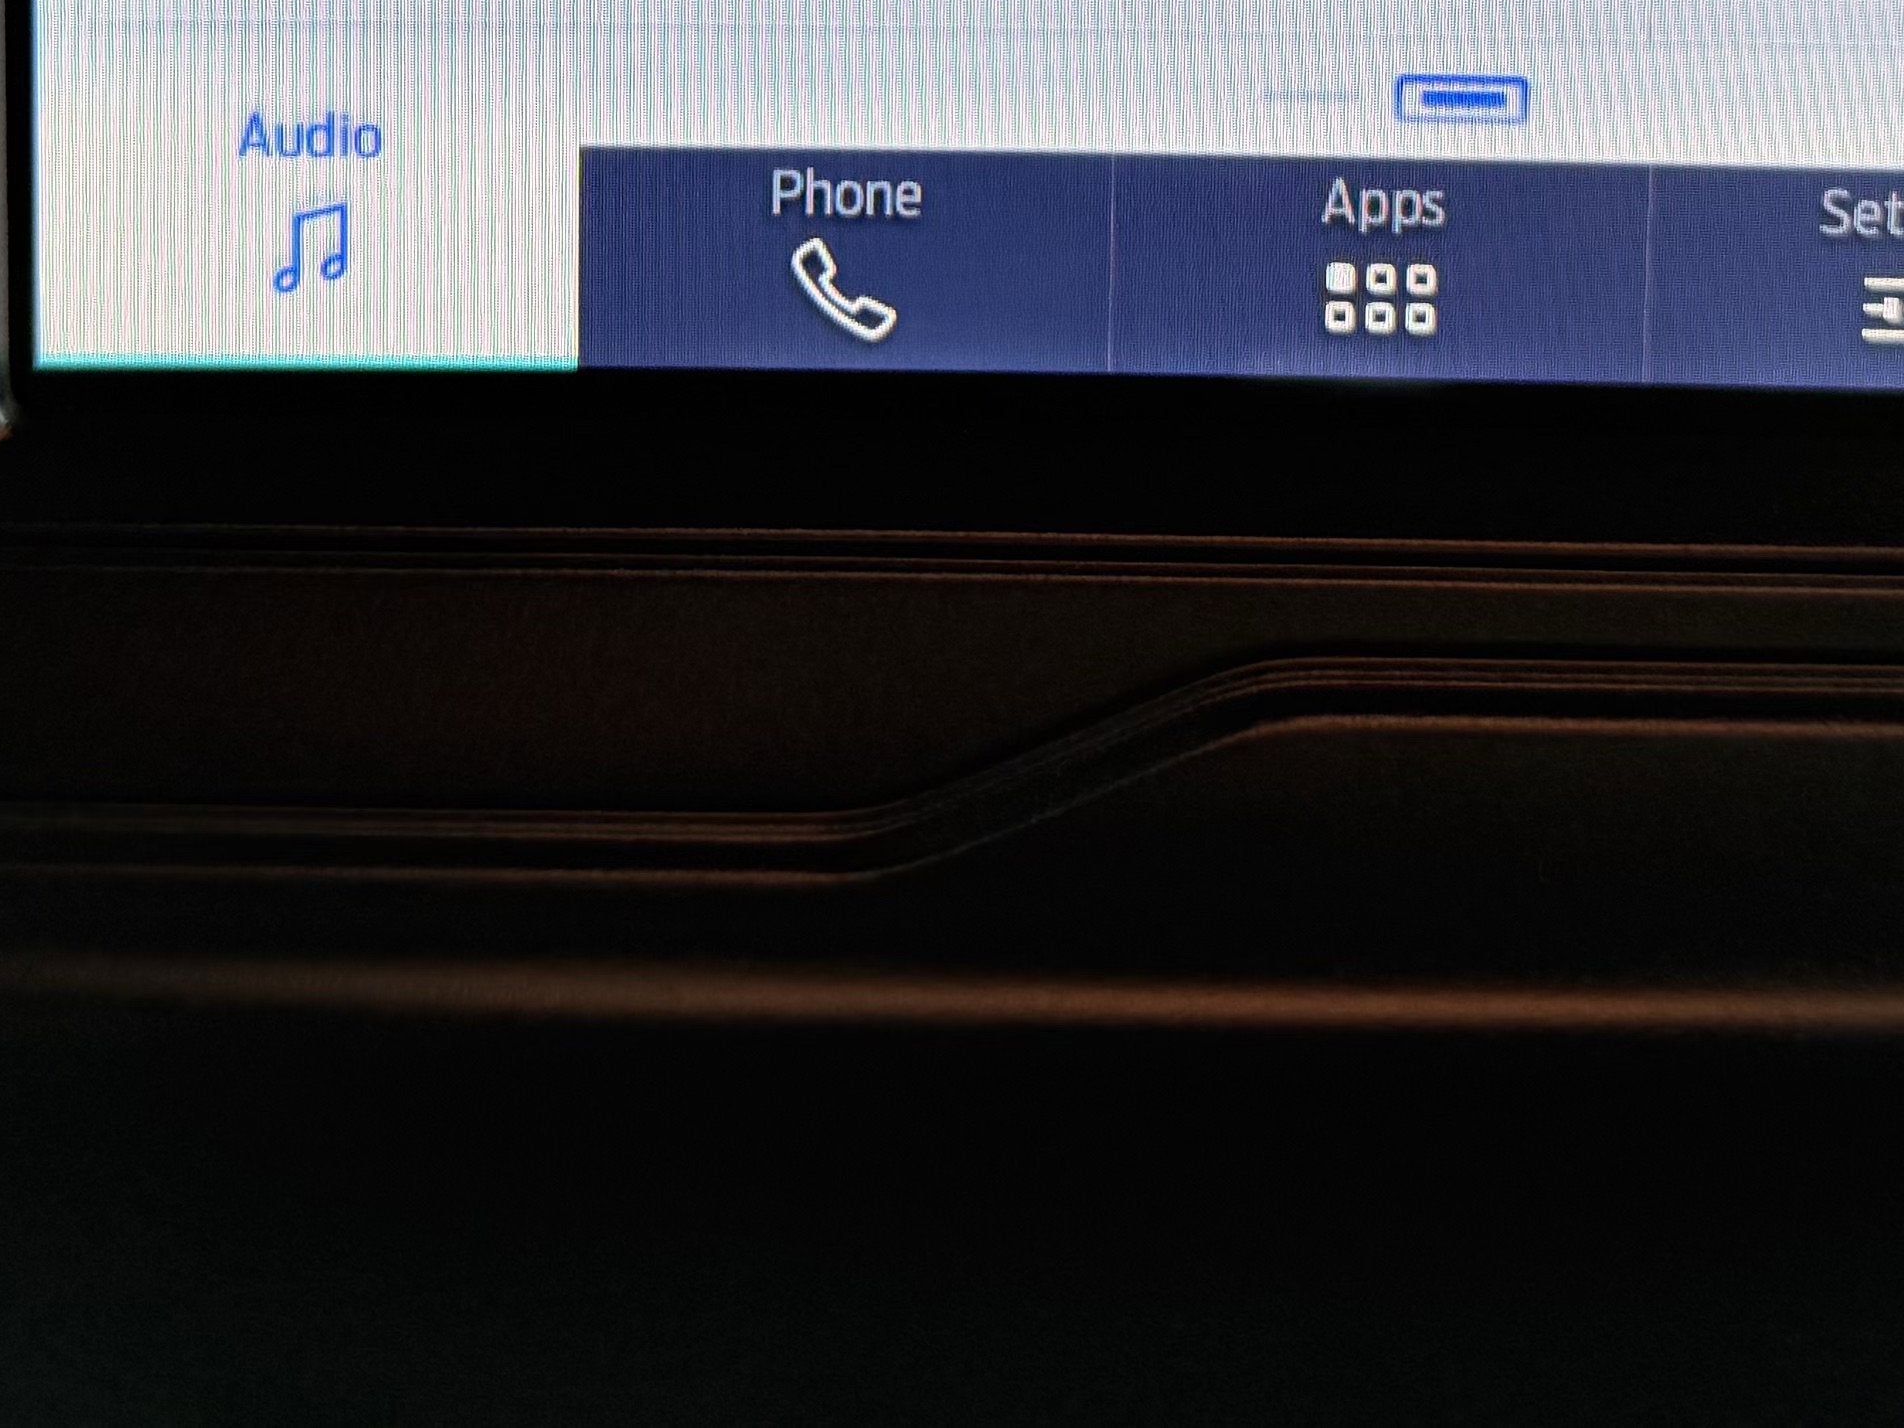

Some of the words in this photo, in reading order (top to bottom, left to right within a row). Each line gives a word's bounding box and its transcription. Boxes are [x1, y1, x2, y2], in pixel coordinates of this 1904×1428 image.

[237, 110, 383, 159] Audio
[769, 168, 924, 218] Phone
[1320, 178, 1447, 233] Apps
